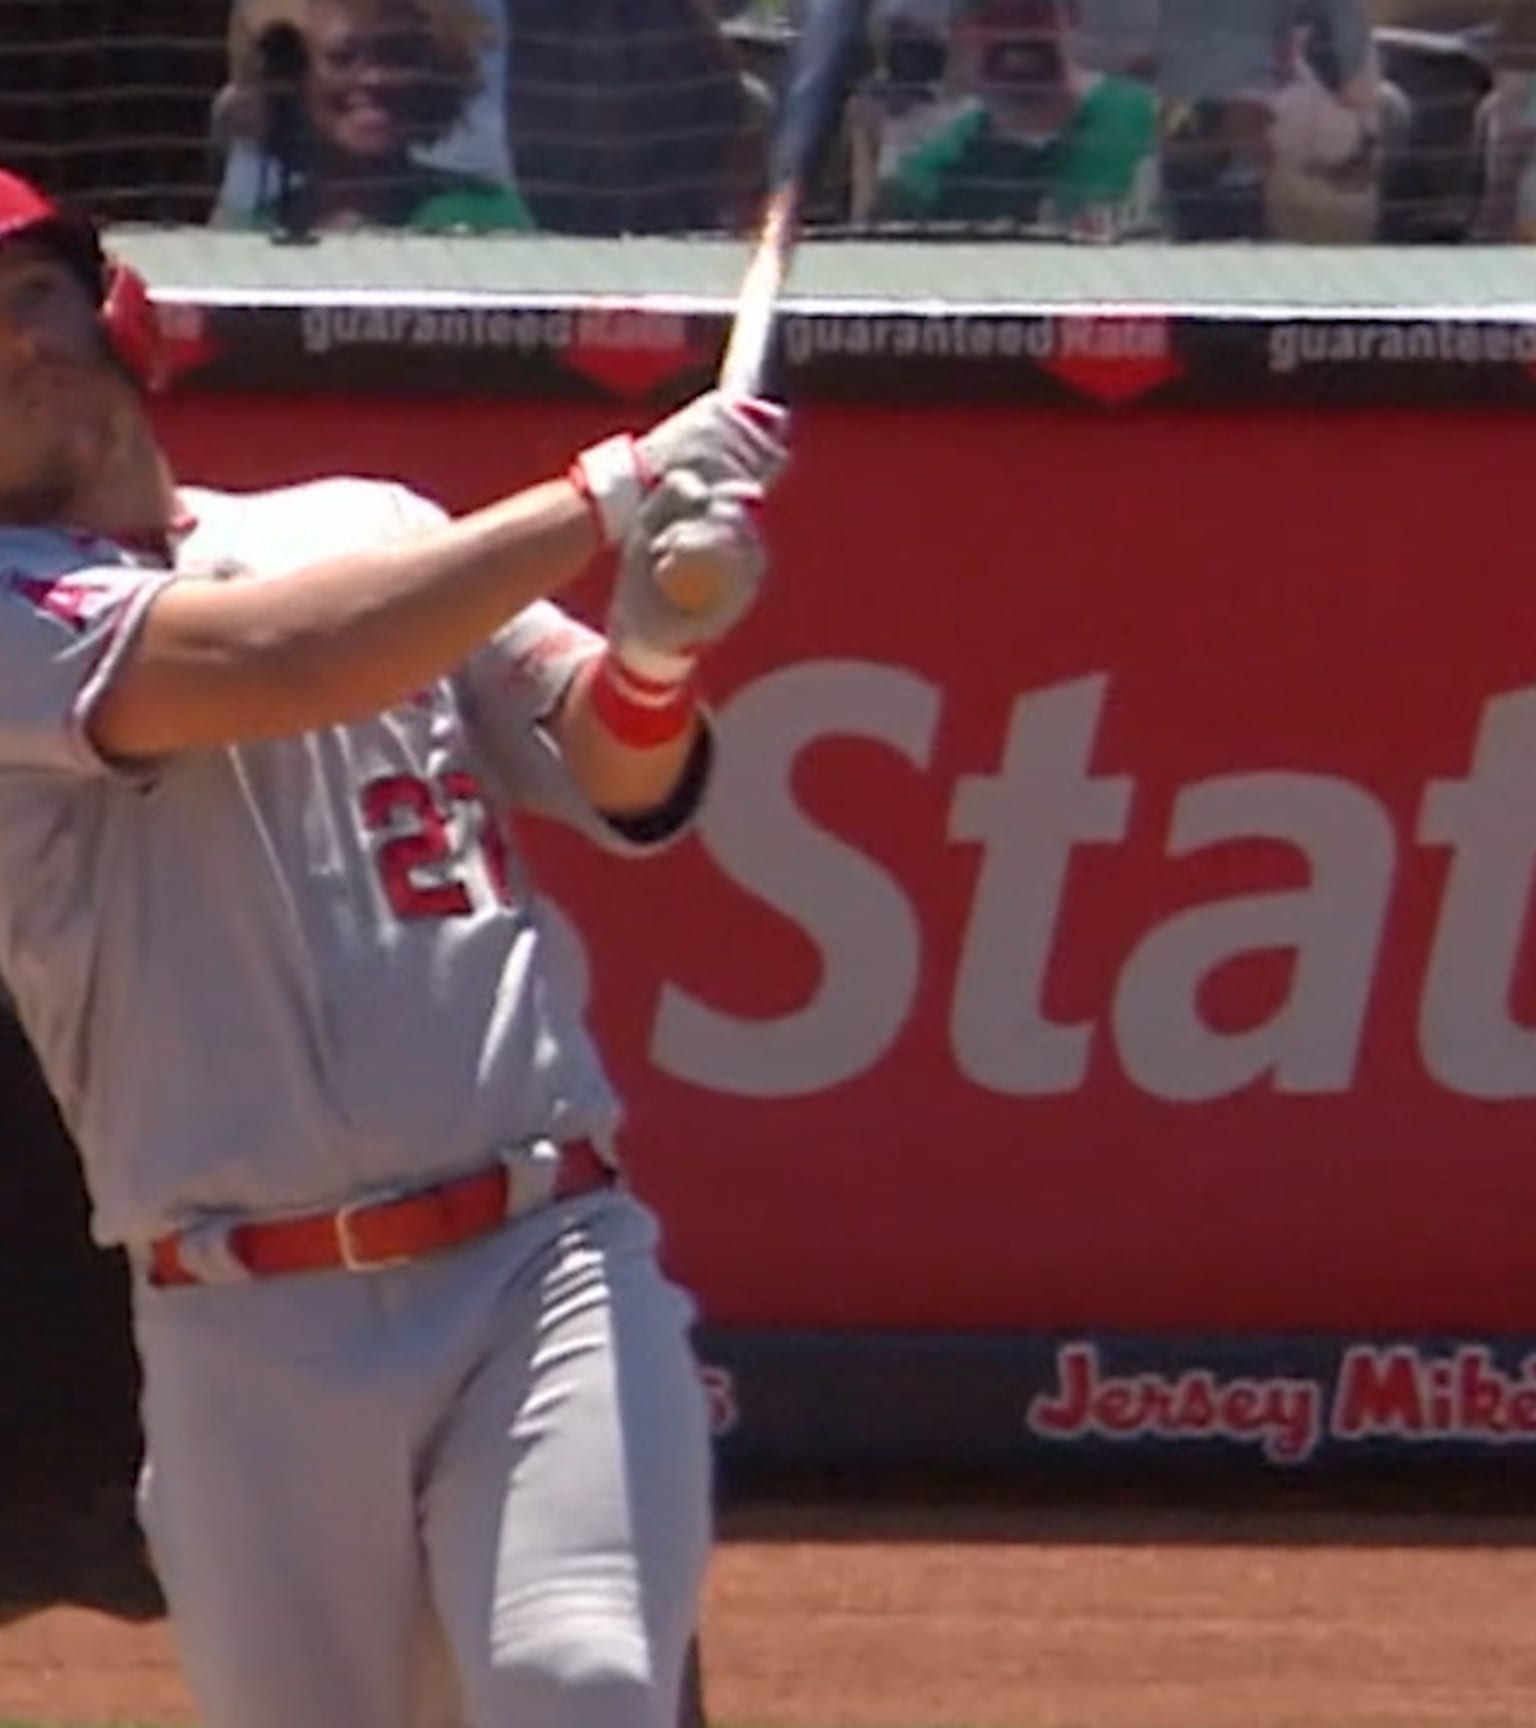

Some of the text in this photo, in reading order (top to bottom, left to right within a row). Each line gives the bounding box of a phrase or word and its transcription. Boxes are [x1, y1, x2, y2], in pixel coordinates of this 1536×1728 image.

[302, 305, 570, 351] guaranteed
[784, 314, 1054, 362] guaranteed
[650, 657, 1536, 1102] Stat
[1028, 1342, 1322, 1463] Jersey
